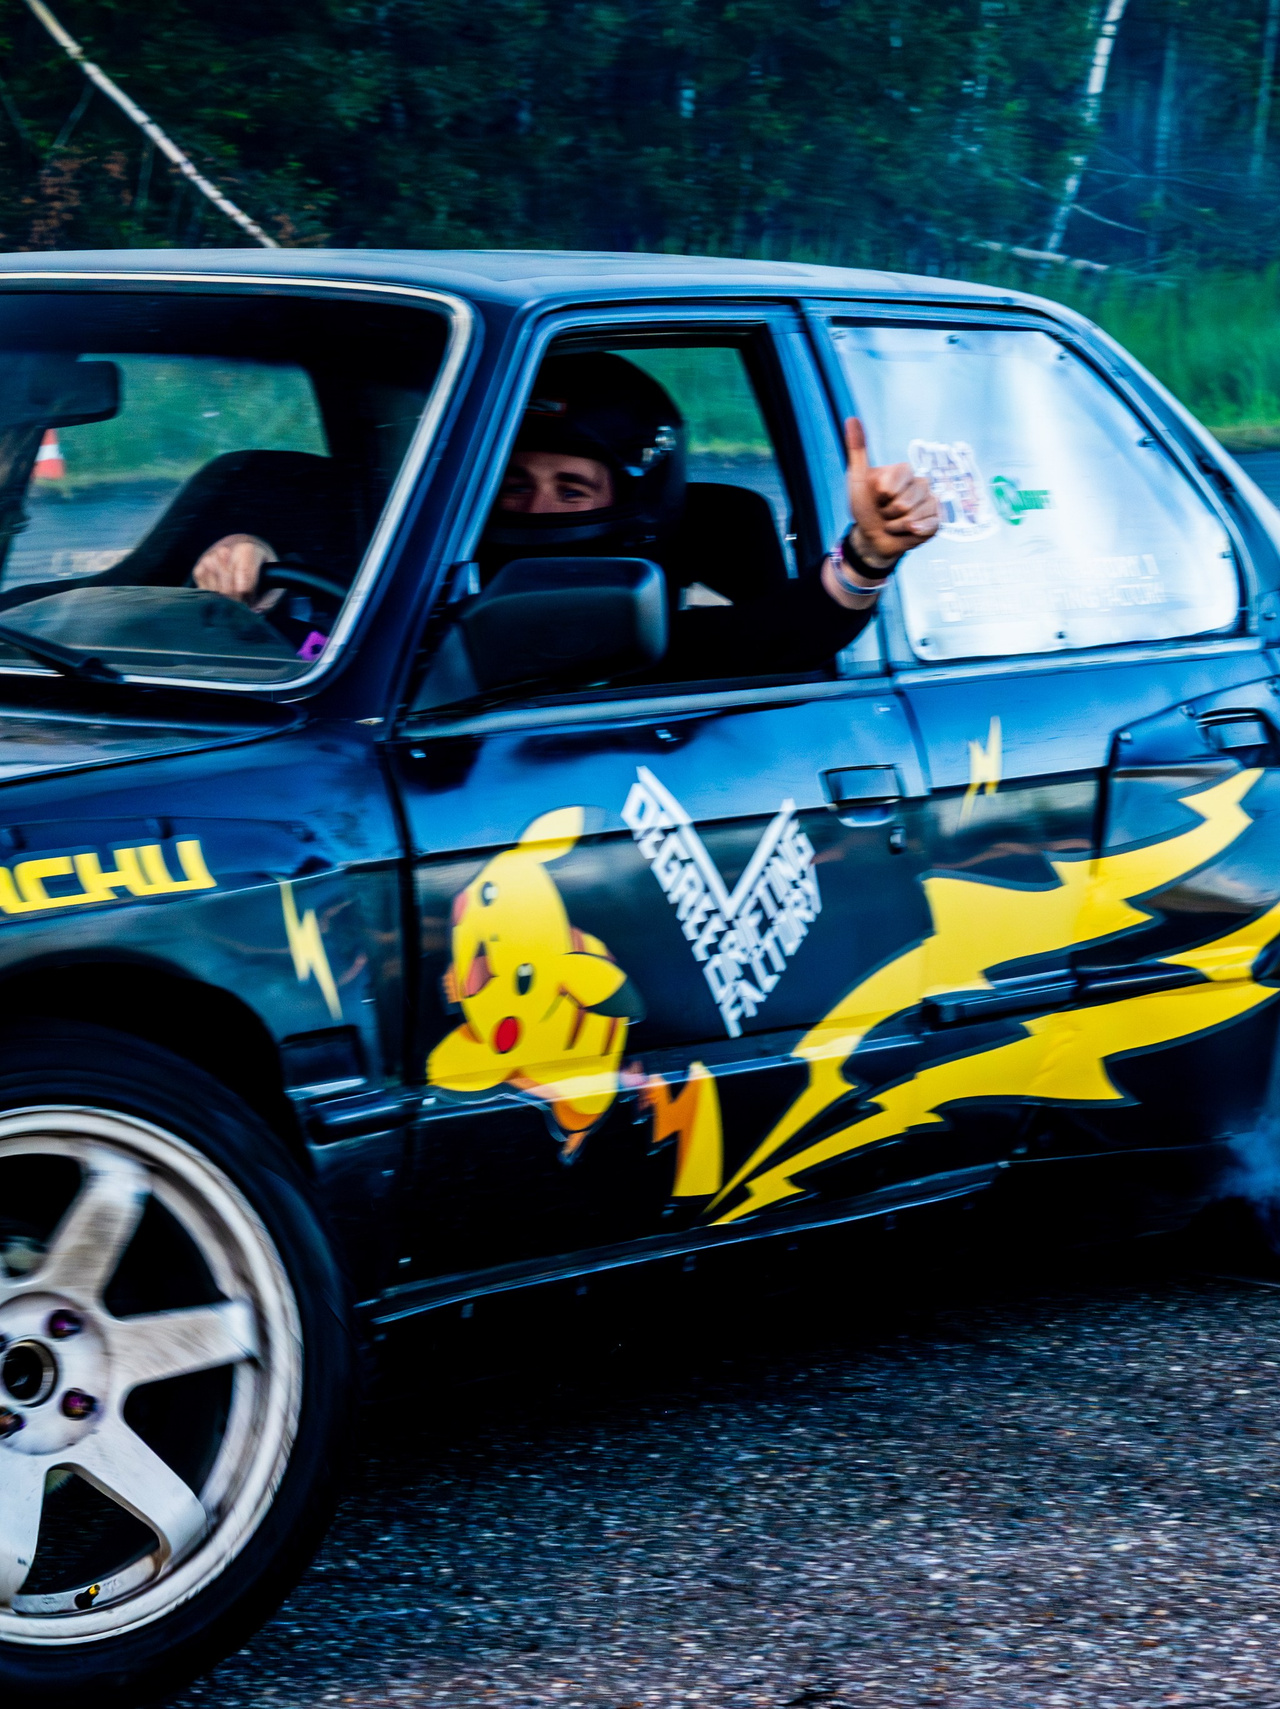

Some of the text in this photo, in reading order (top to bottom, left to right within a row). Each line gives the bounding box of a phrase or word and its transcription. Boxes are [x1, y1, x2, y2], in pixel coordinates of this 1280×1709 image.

[620, 782, 729, 962] DEGREE
[703, 818, 817, 1004] DRIFTING
[718, 862, 823, 1039] FACTORY
